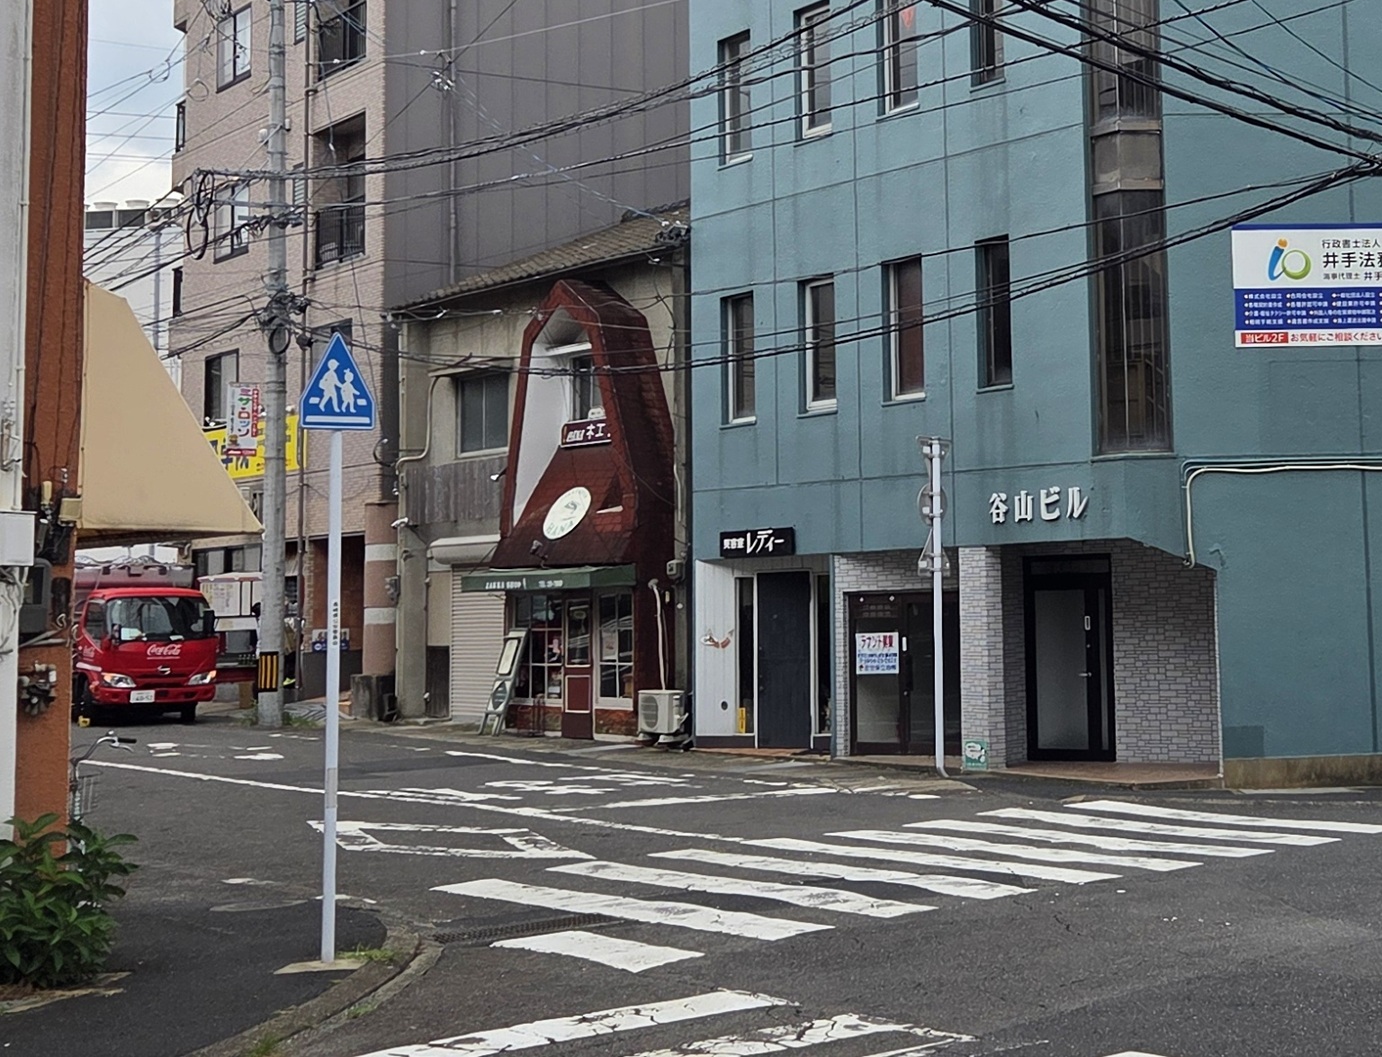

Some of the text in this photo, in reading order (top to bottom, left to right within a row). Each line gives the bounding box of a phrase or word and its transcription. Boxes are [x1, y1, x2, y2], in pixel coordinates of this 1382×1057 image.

[1321, 238, 1381, 249] 行政書士法人
[1245, 333, 1285, 343] 当ビル2F
[988, 486, 1089, 524] 谷山ビル
